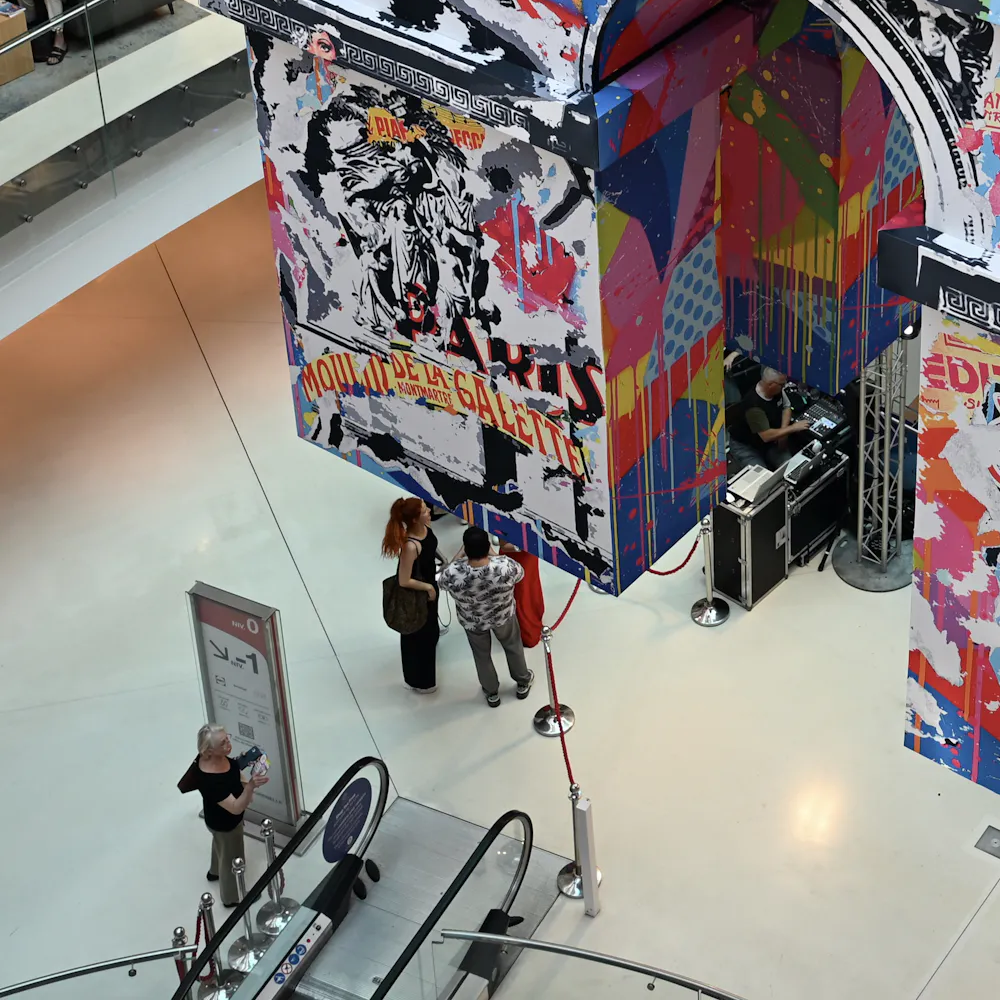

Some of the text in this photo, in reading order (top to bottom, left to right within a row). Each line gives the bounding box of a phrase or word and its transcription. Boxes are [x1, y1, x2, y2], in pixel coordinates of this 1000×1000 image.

[389, 351, 420, 382] DE
[423, 363, 451, 390] LA
[453, 368, 587, 482] GALETTE
